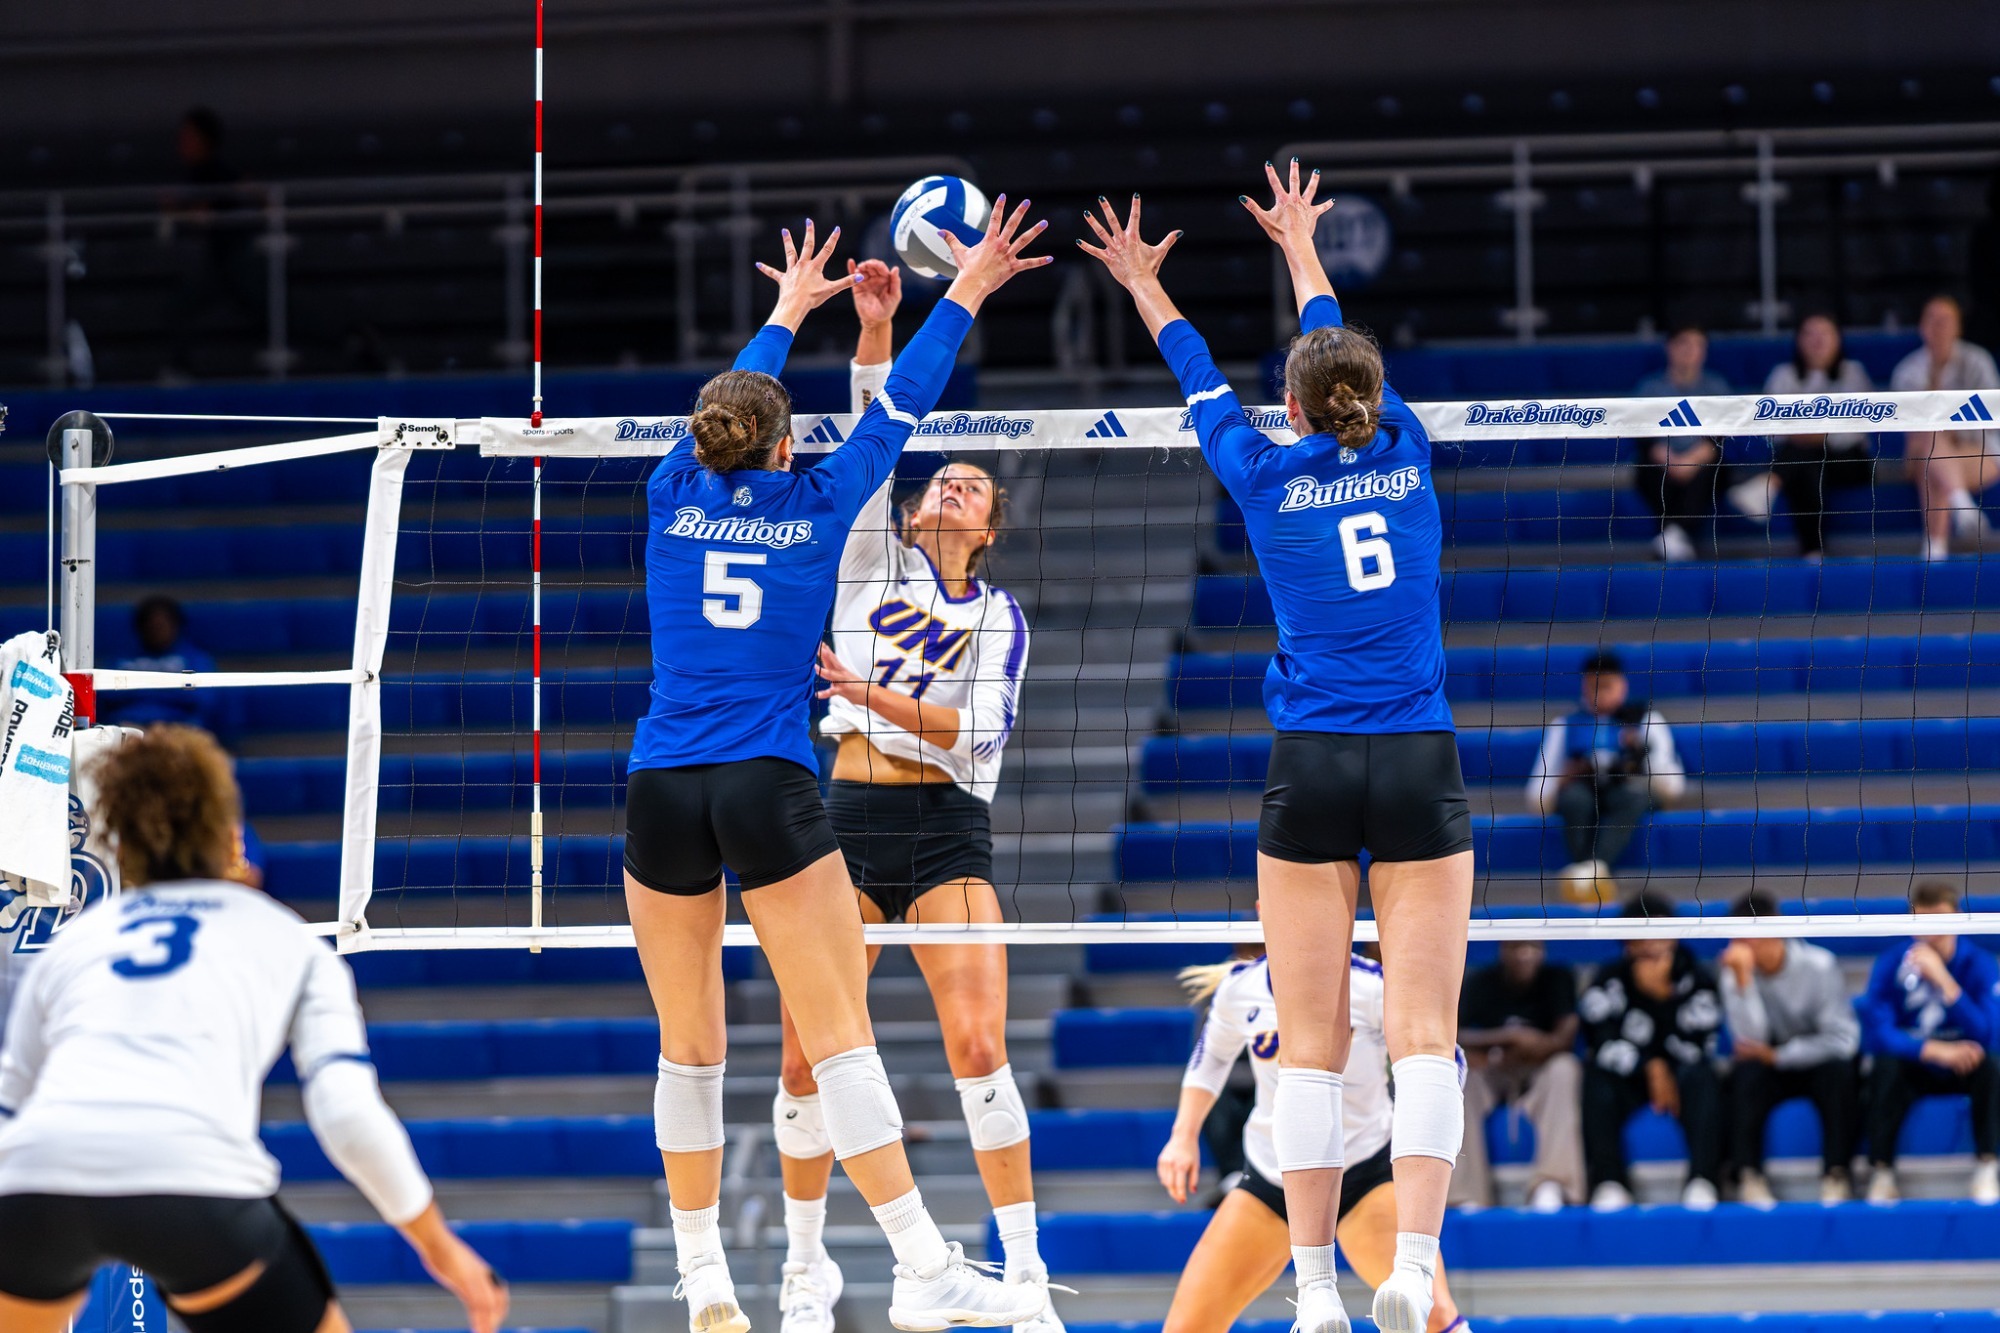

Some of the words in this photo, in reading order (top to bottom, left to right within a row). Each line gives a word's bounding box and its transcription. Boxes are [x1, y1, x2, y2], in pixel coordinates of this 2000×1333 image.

[408, 424, 440, 432] Senoh
[912, 413, 1034, 439] rakeBulldogs
[1278, 466, 1420, 512] Bulldogs
[664, 506, 813, 550] Bulldogs
[1338, 511, 1396, 592] 6
[703, 550, 767, 629] 5
[868, 598, 973, 674] UNI
[111, 915, 201, 979] 3
[129, 1264, 145, 1333] spor
